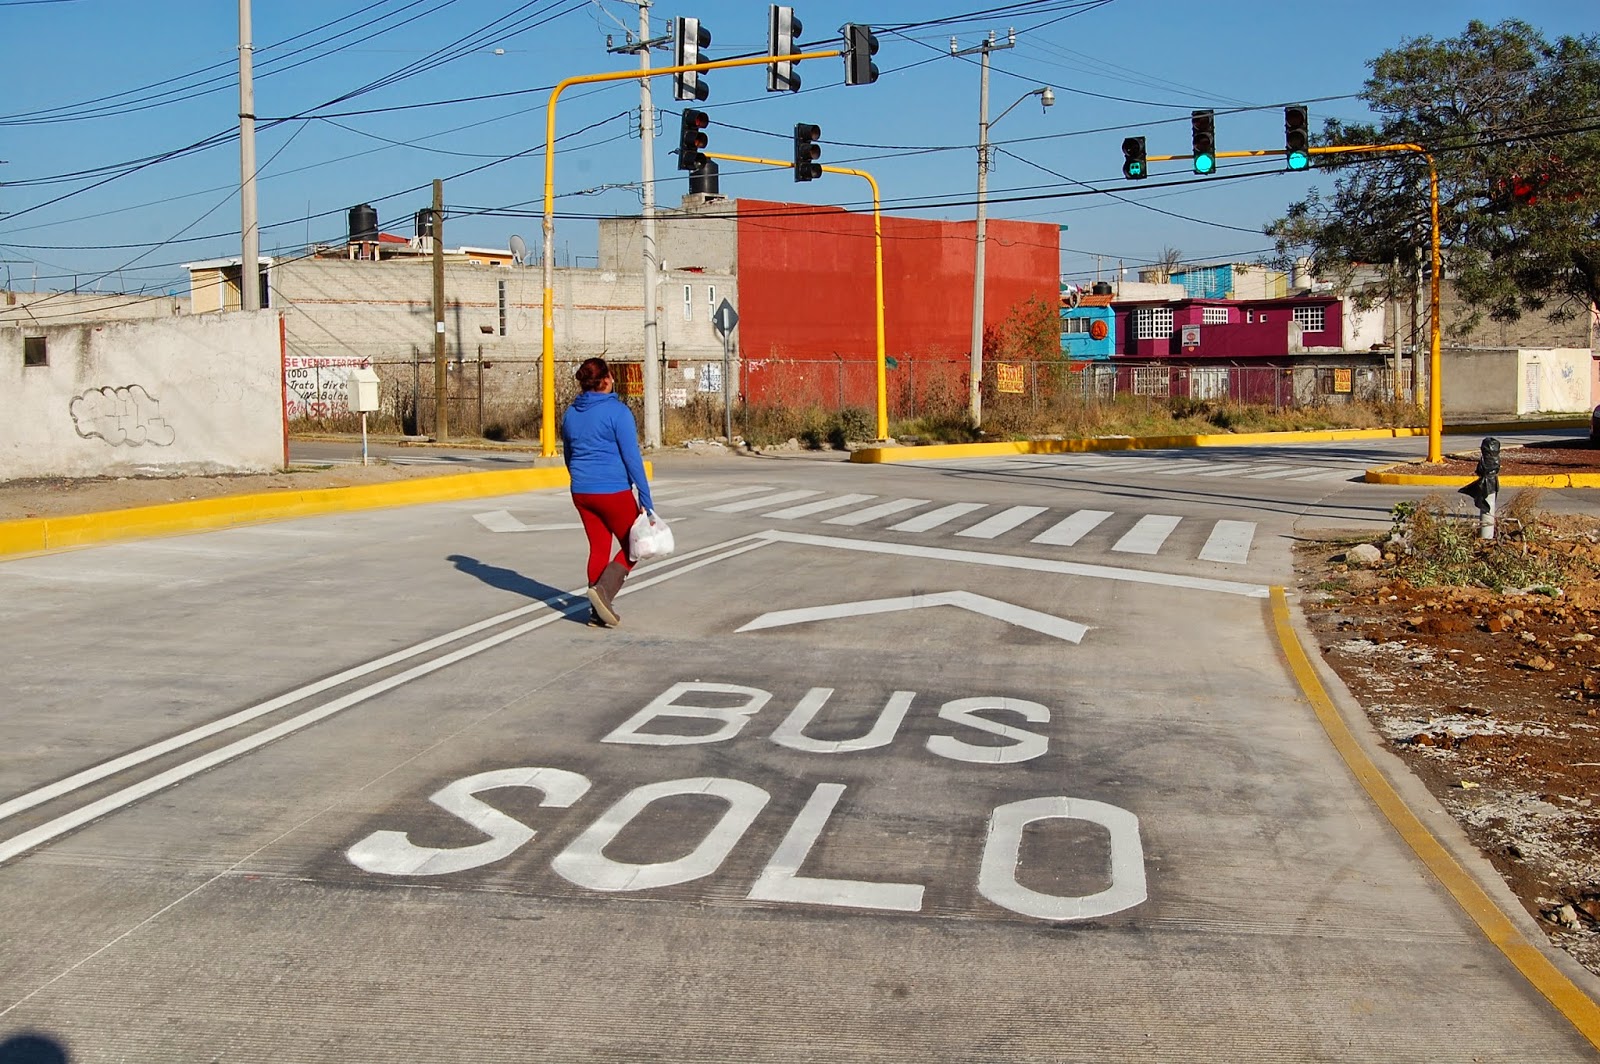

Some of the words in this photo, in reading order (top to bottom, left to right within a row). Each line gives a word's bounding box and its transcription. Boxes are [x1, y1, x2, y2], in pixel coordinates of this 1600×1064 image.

[290, 380, 315, 390] Trato
[601, 681, 1051, 764] BUS
[345, 767, 1149, 920] SOLO
